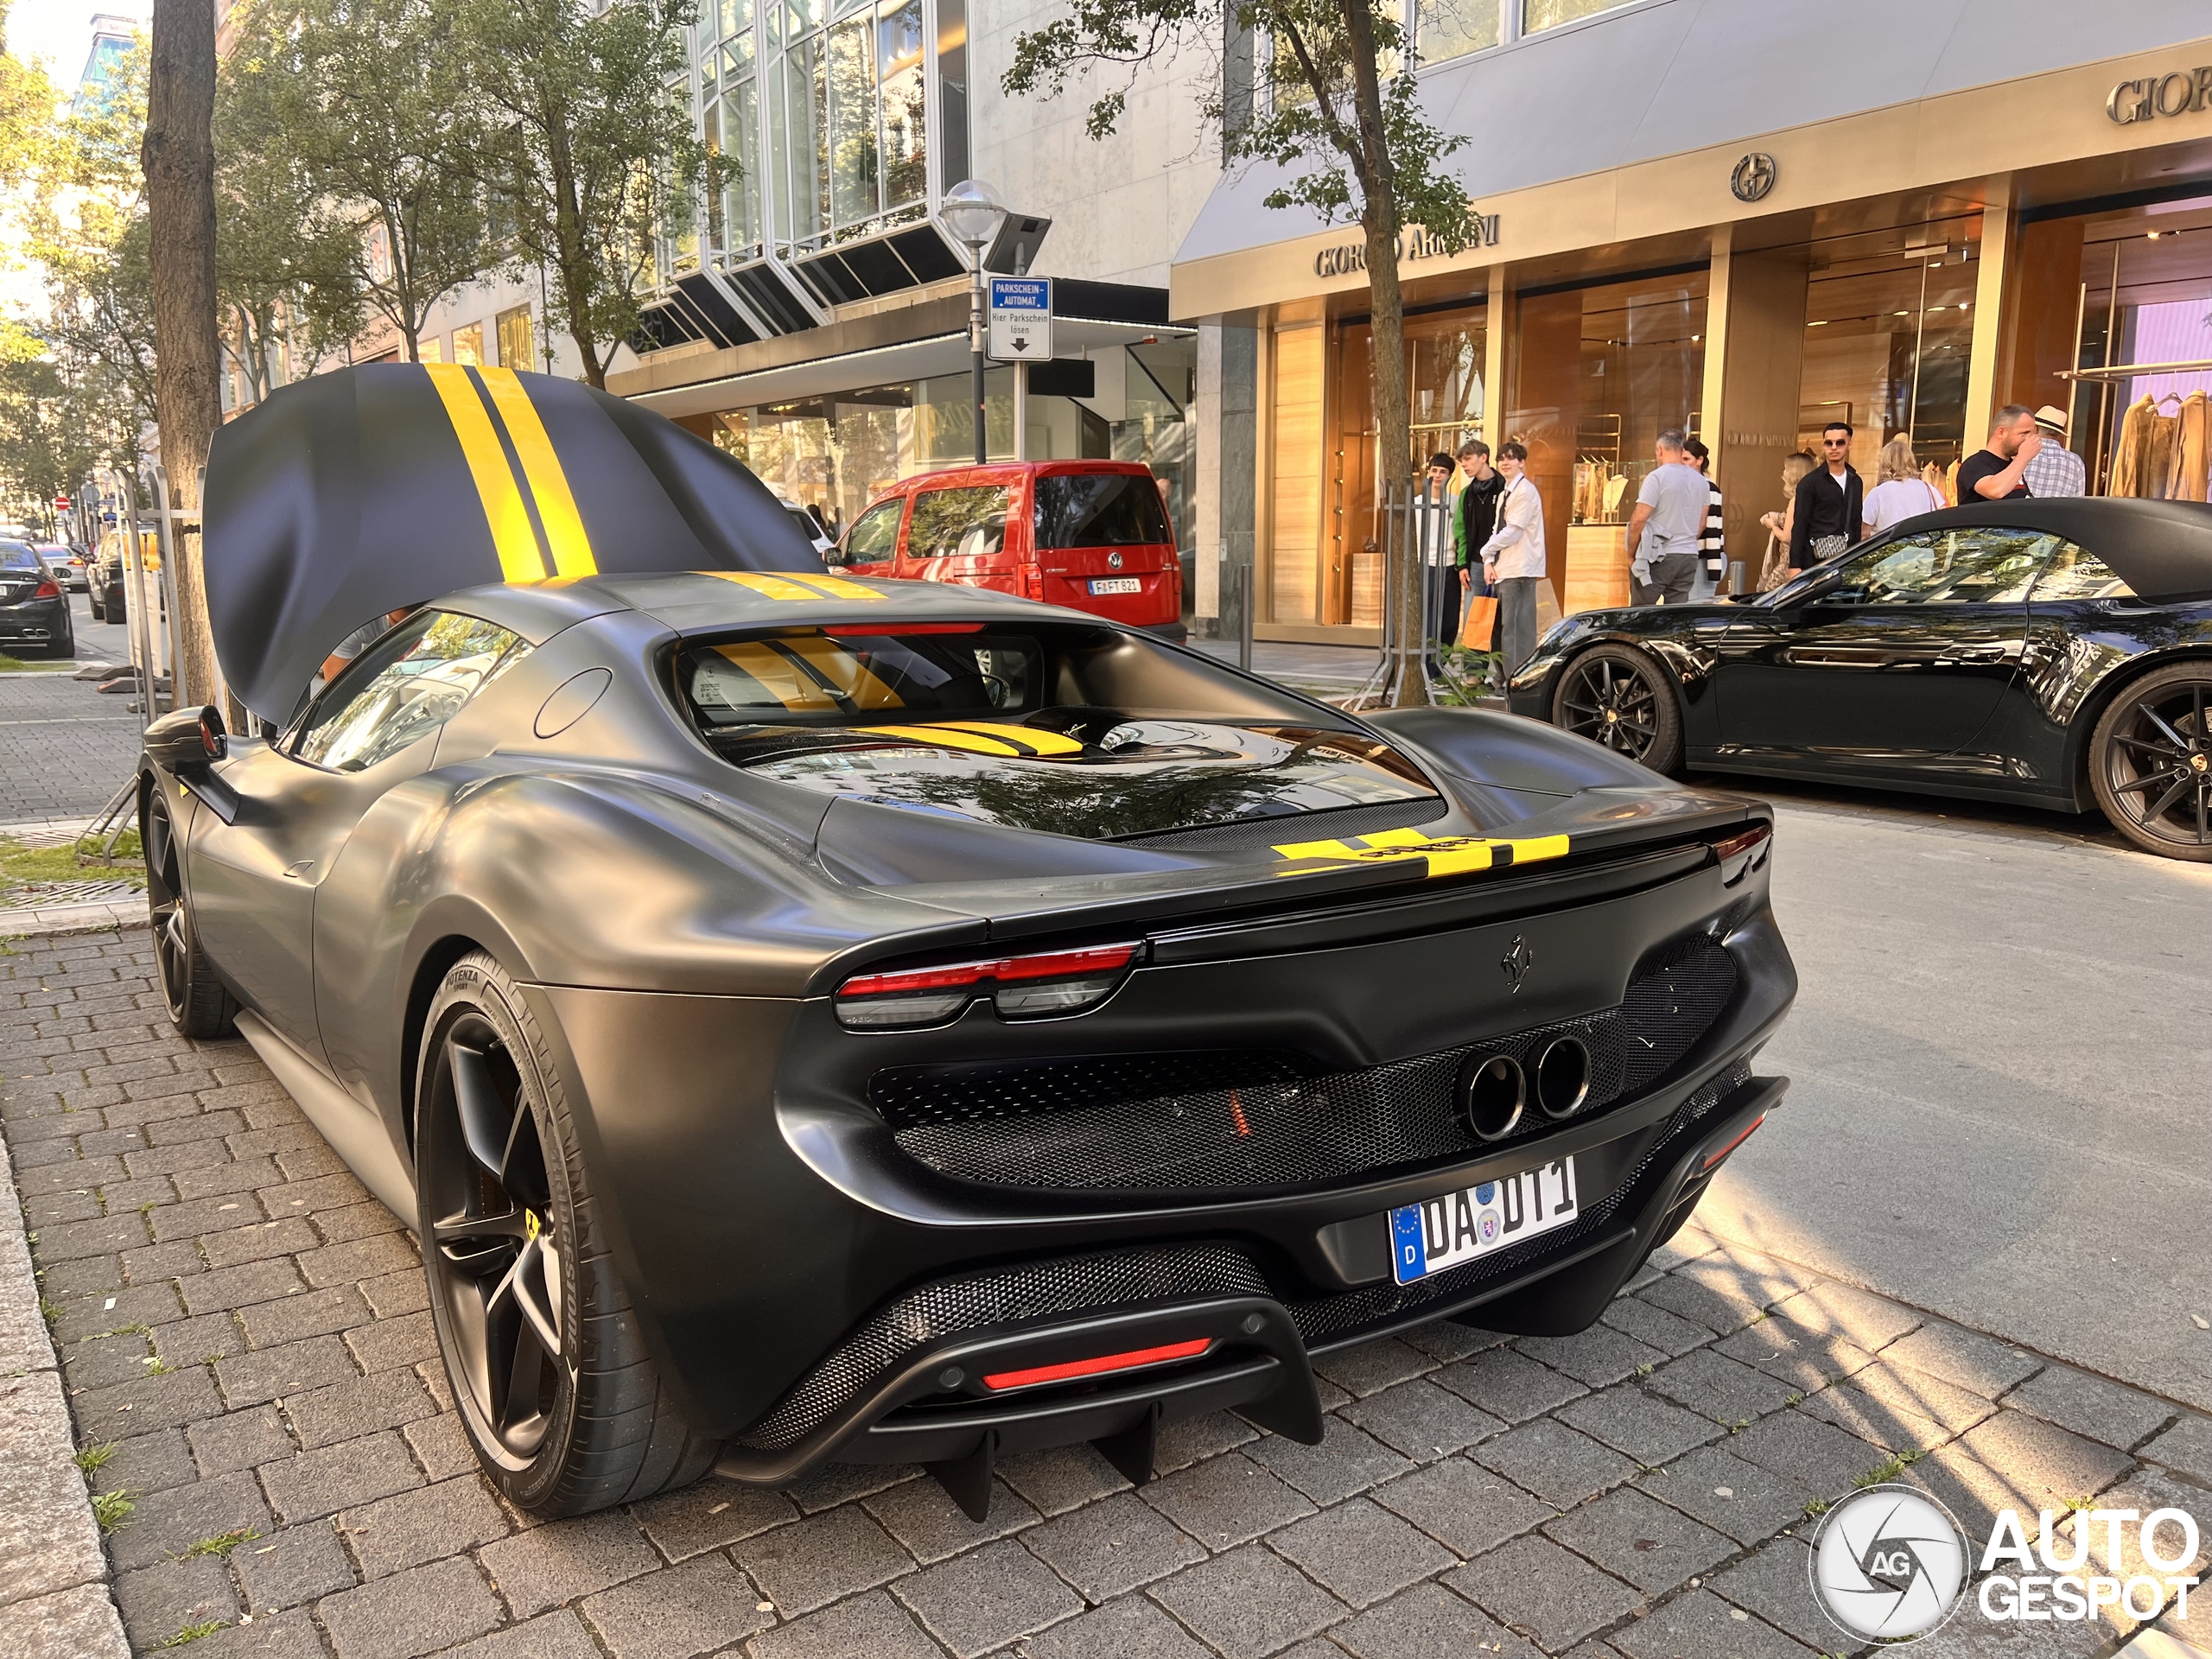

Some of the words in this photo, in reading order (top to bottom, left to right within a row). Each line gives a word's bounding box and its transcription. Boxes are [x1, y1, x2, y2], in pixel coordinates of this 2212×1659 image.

[995, 283, 1044, 294] PARKSCHEIN-
[1004, 296, 1036, 306] AUTOMAT
[992, 313, 1007, 321] Hier
[1010, 313, 1048, 322] Parkschein
[1011, 325, 1030, 334] lösen
[1096, 582, 1102, 593] F
[1108, 581, 1119, 592] FT
[1121, 580, 1137, 591] 821
[445, 969, 479, 990] POTENZA
[453, 982, 468, 993] SPORT
[1421, 1190, 1478, 1261] DA
[552, 1159, 577, 1355] BRIDGESTONE
[1404, 1244, 1416, 1265] D
